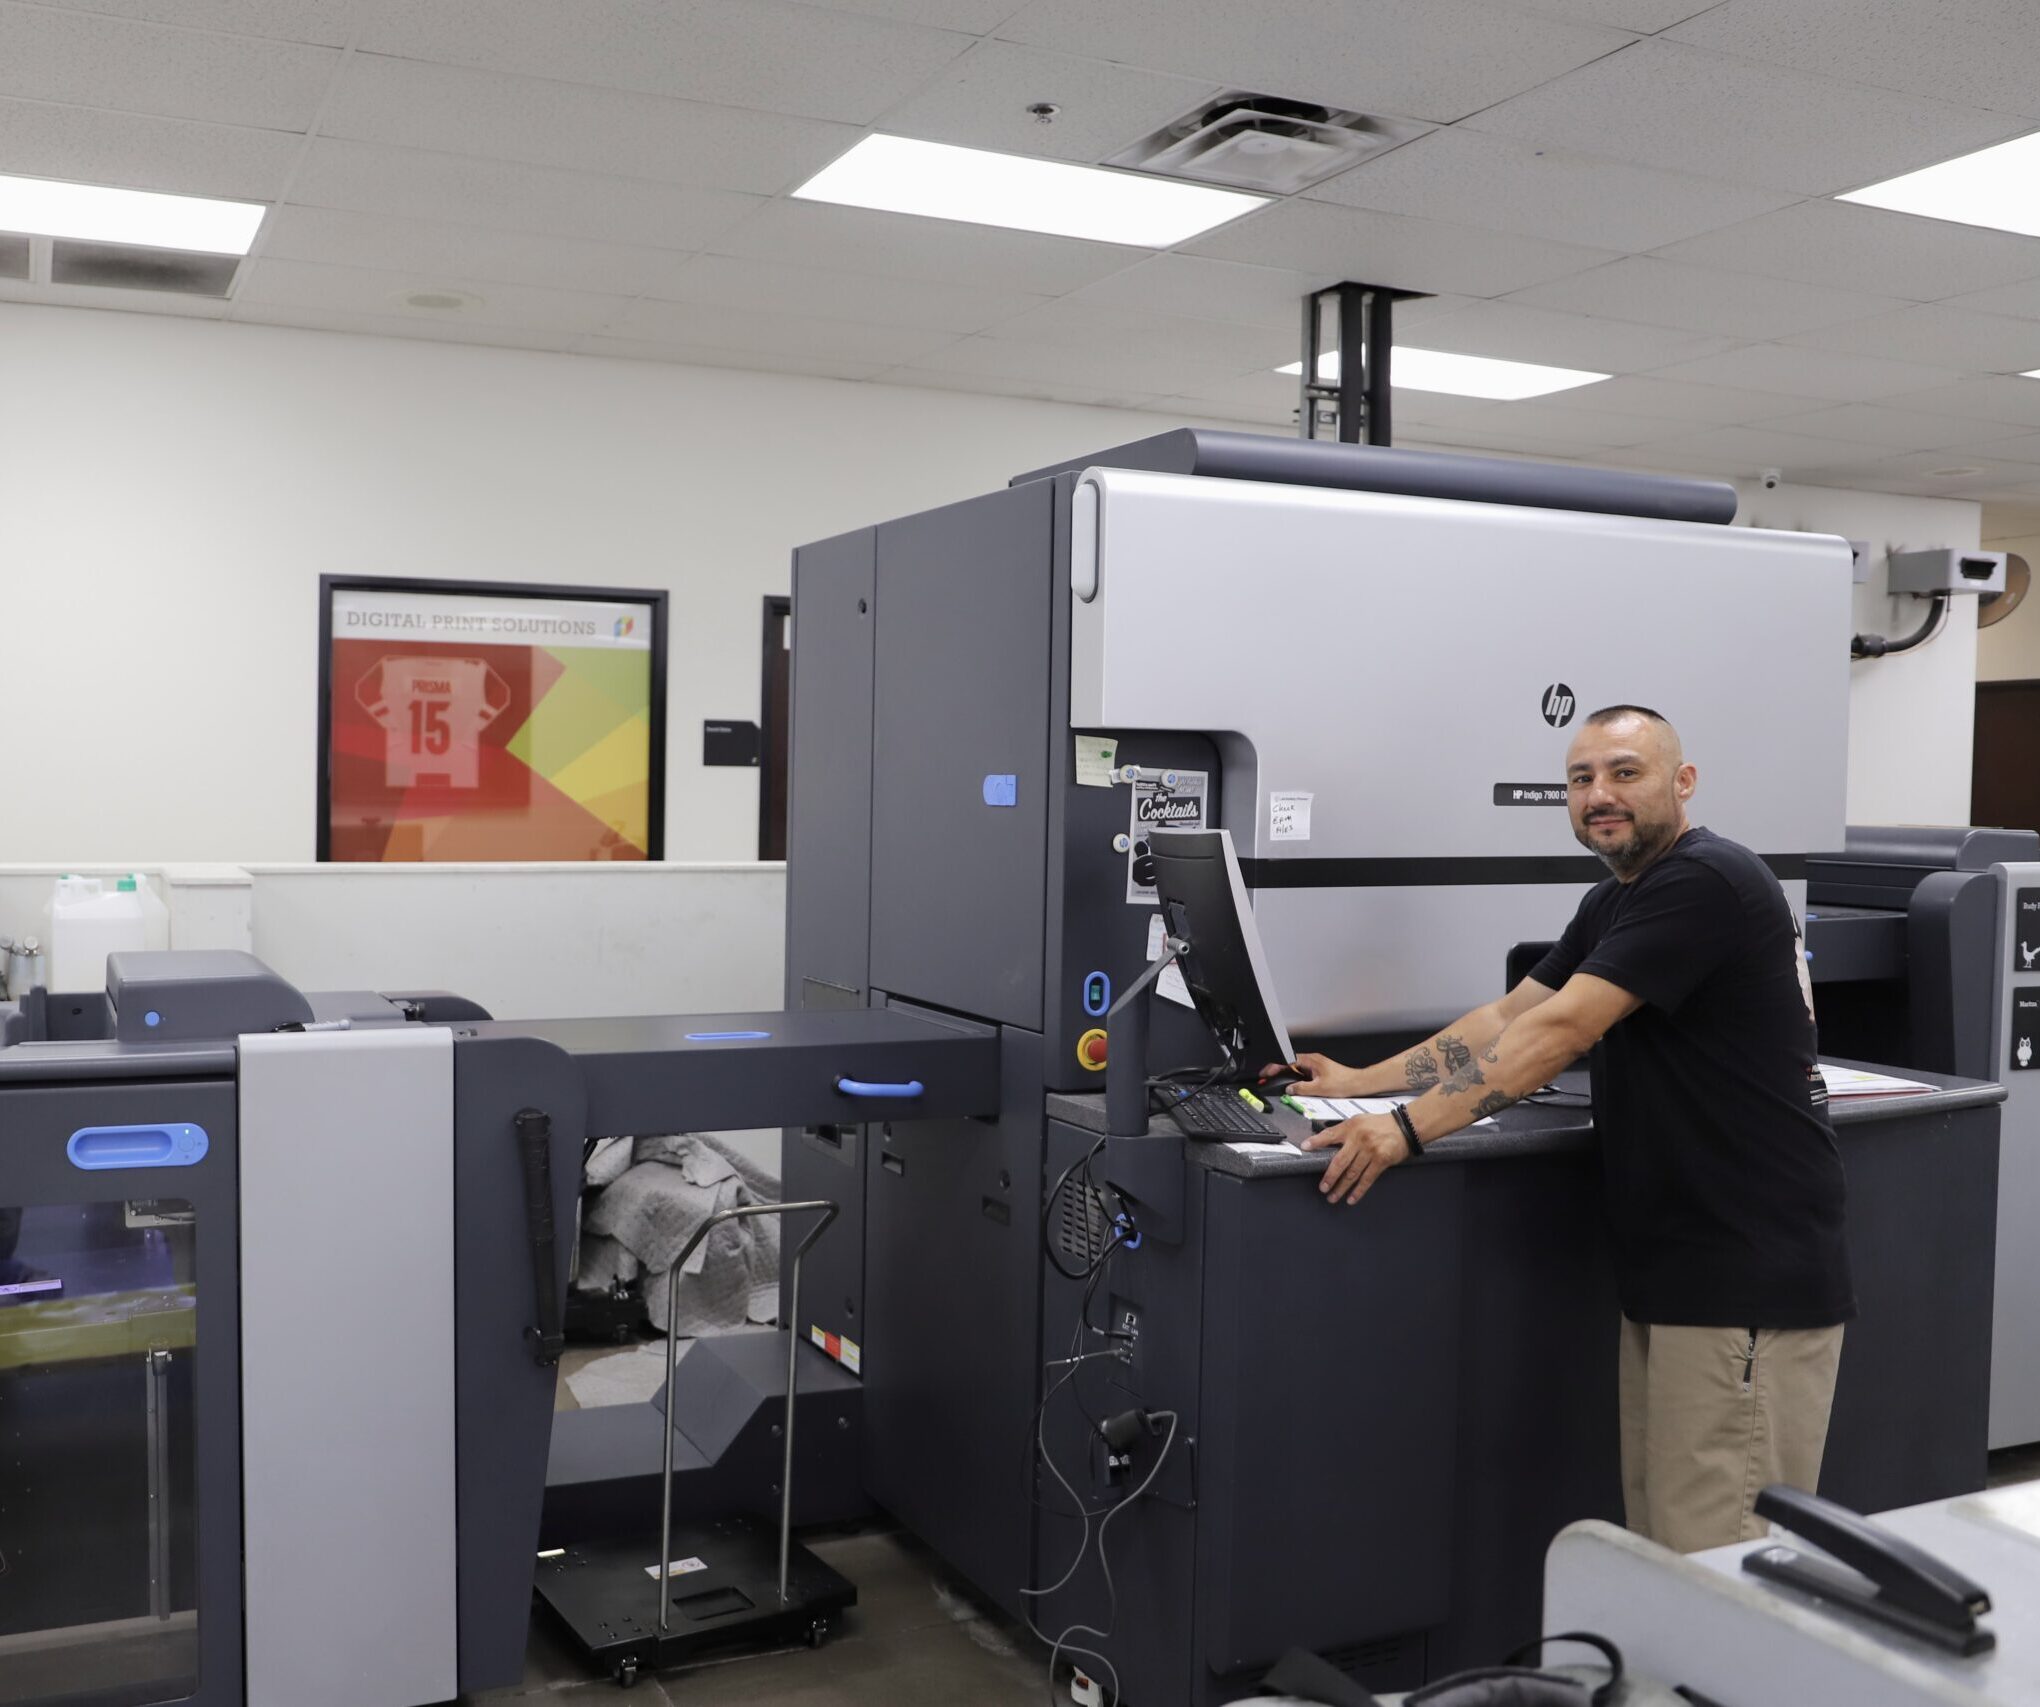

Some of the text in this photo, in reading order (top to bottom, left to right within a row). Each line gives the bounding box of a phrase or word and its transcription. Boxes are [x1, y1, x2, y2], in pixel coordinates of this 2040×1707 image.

[346, 611, 597, 636] DIGITAL PRINT SOLUTIONS
[412, 680, 451, 693] PRISMA
[1543, 683, 1575, 728] hp
[408, 700, 450, 755] 15
[1155, 792, 1168, 802] the
[1512, 790, 1523, 800] HP
[1523, 790, 1543, 801] Indigo
[1543, 790, 1560, 800] 7900
[1140, 798, 1198, 820] Cocktails
